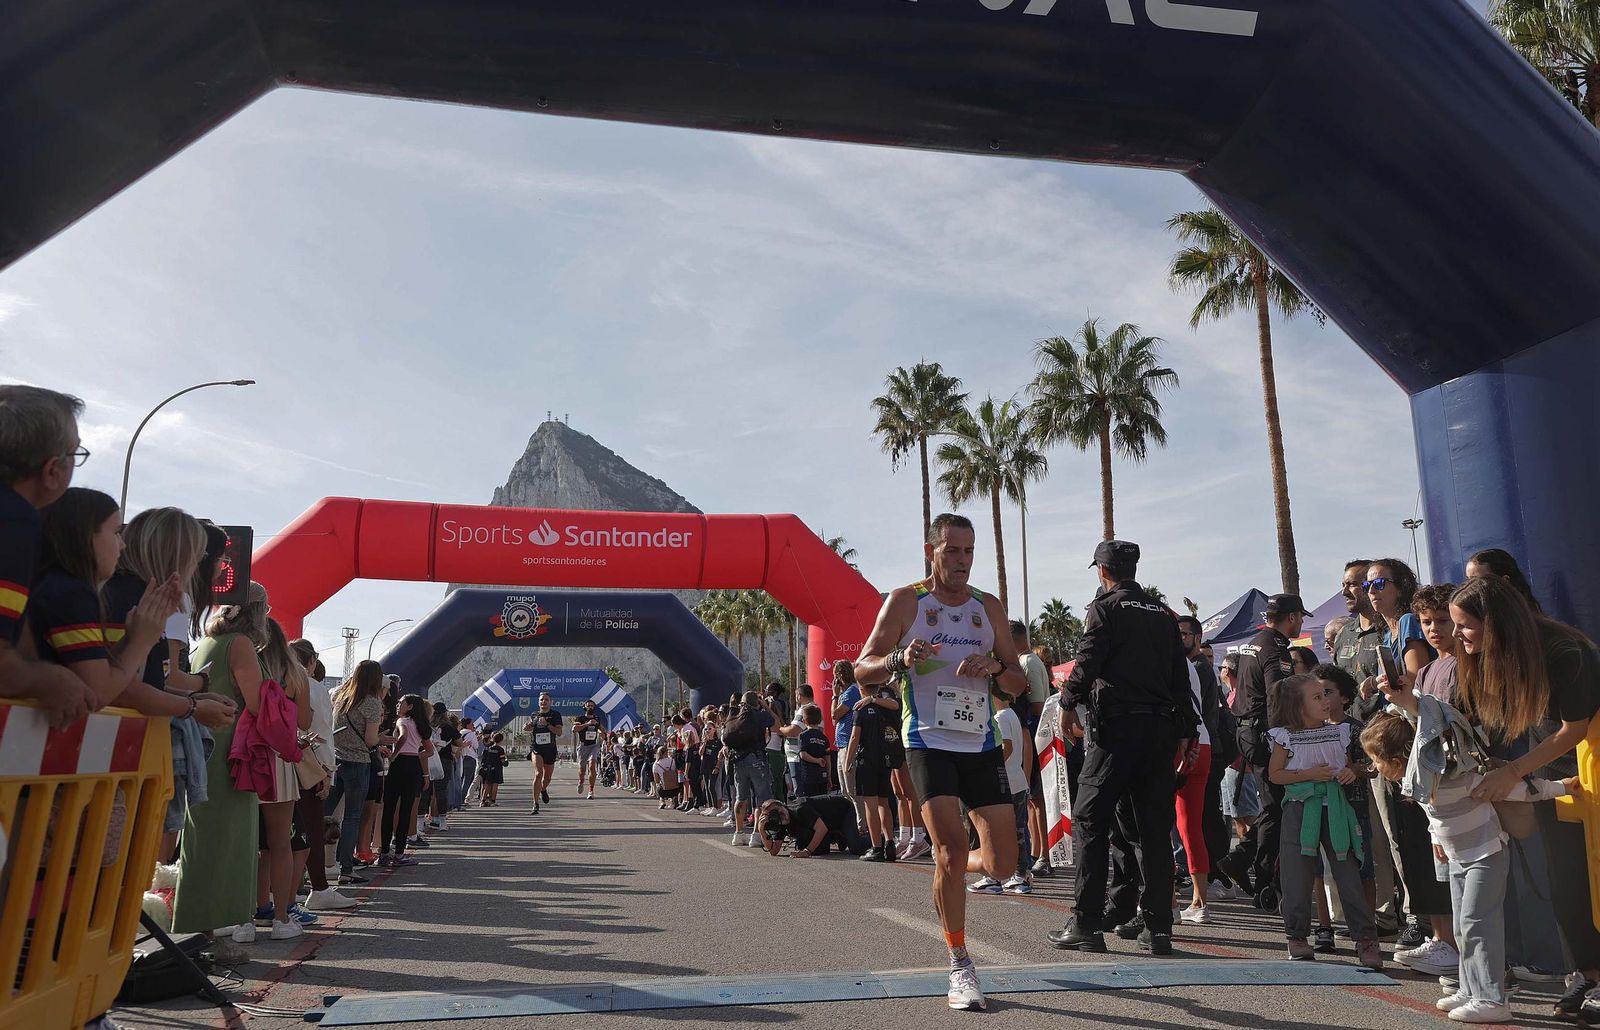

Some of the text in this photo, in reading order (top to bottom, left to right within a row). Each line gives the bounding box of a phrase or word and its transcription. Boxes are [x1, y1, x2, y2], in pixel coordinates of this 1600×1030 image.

[441, 520, 693, 549] Sports Santander
[522, 556, 607, 566] sportssantander.es
[506, 595, 536, 603] mupol
[580, 608, 633, 618] Mutualidad
[580, 619, 639, 629] de la Policía
[930, 632, 983, 647] Chipiona
[836, 640, 866, 653] Sport
[533, 676, 561, 684] Diputación
[550, 699, 561, 707] La
[953, 708, 974, 723] 556
